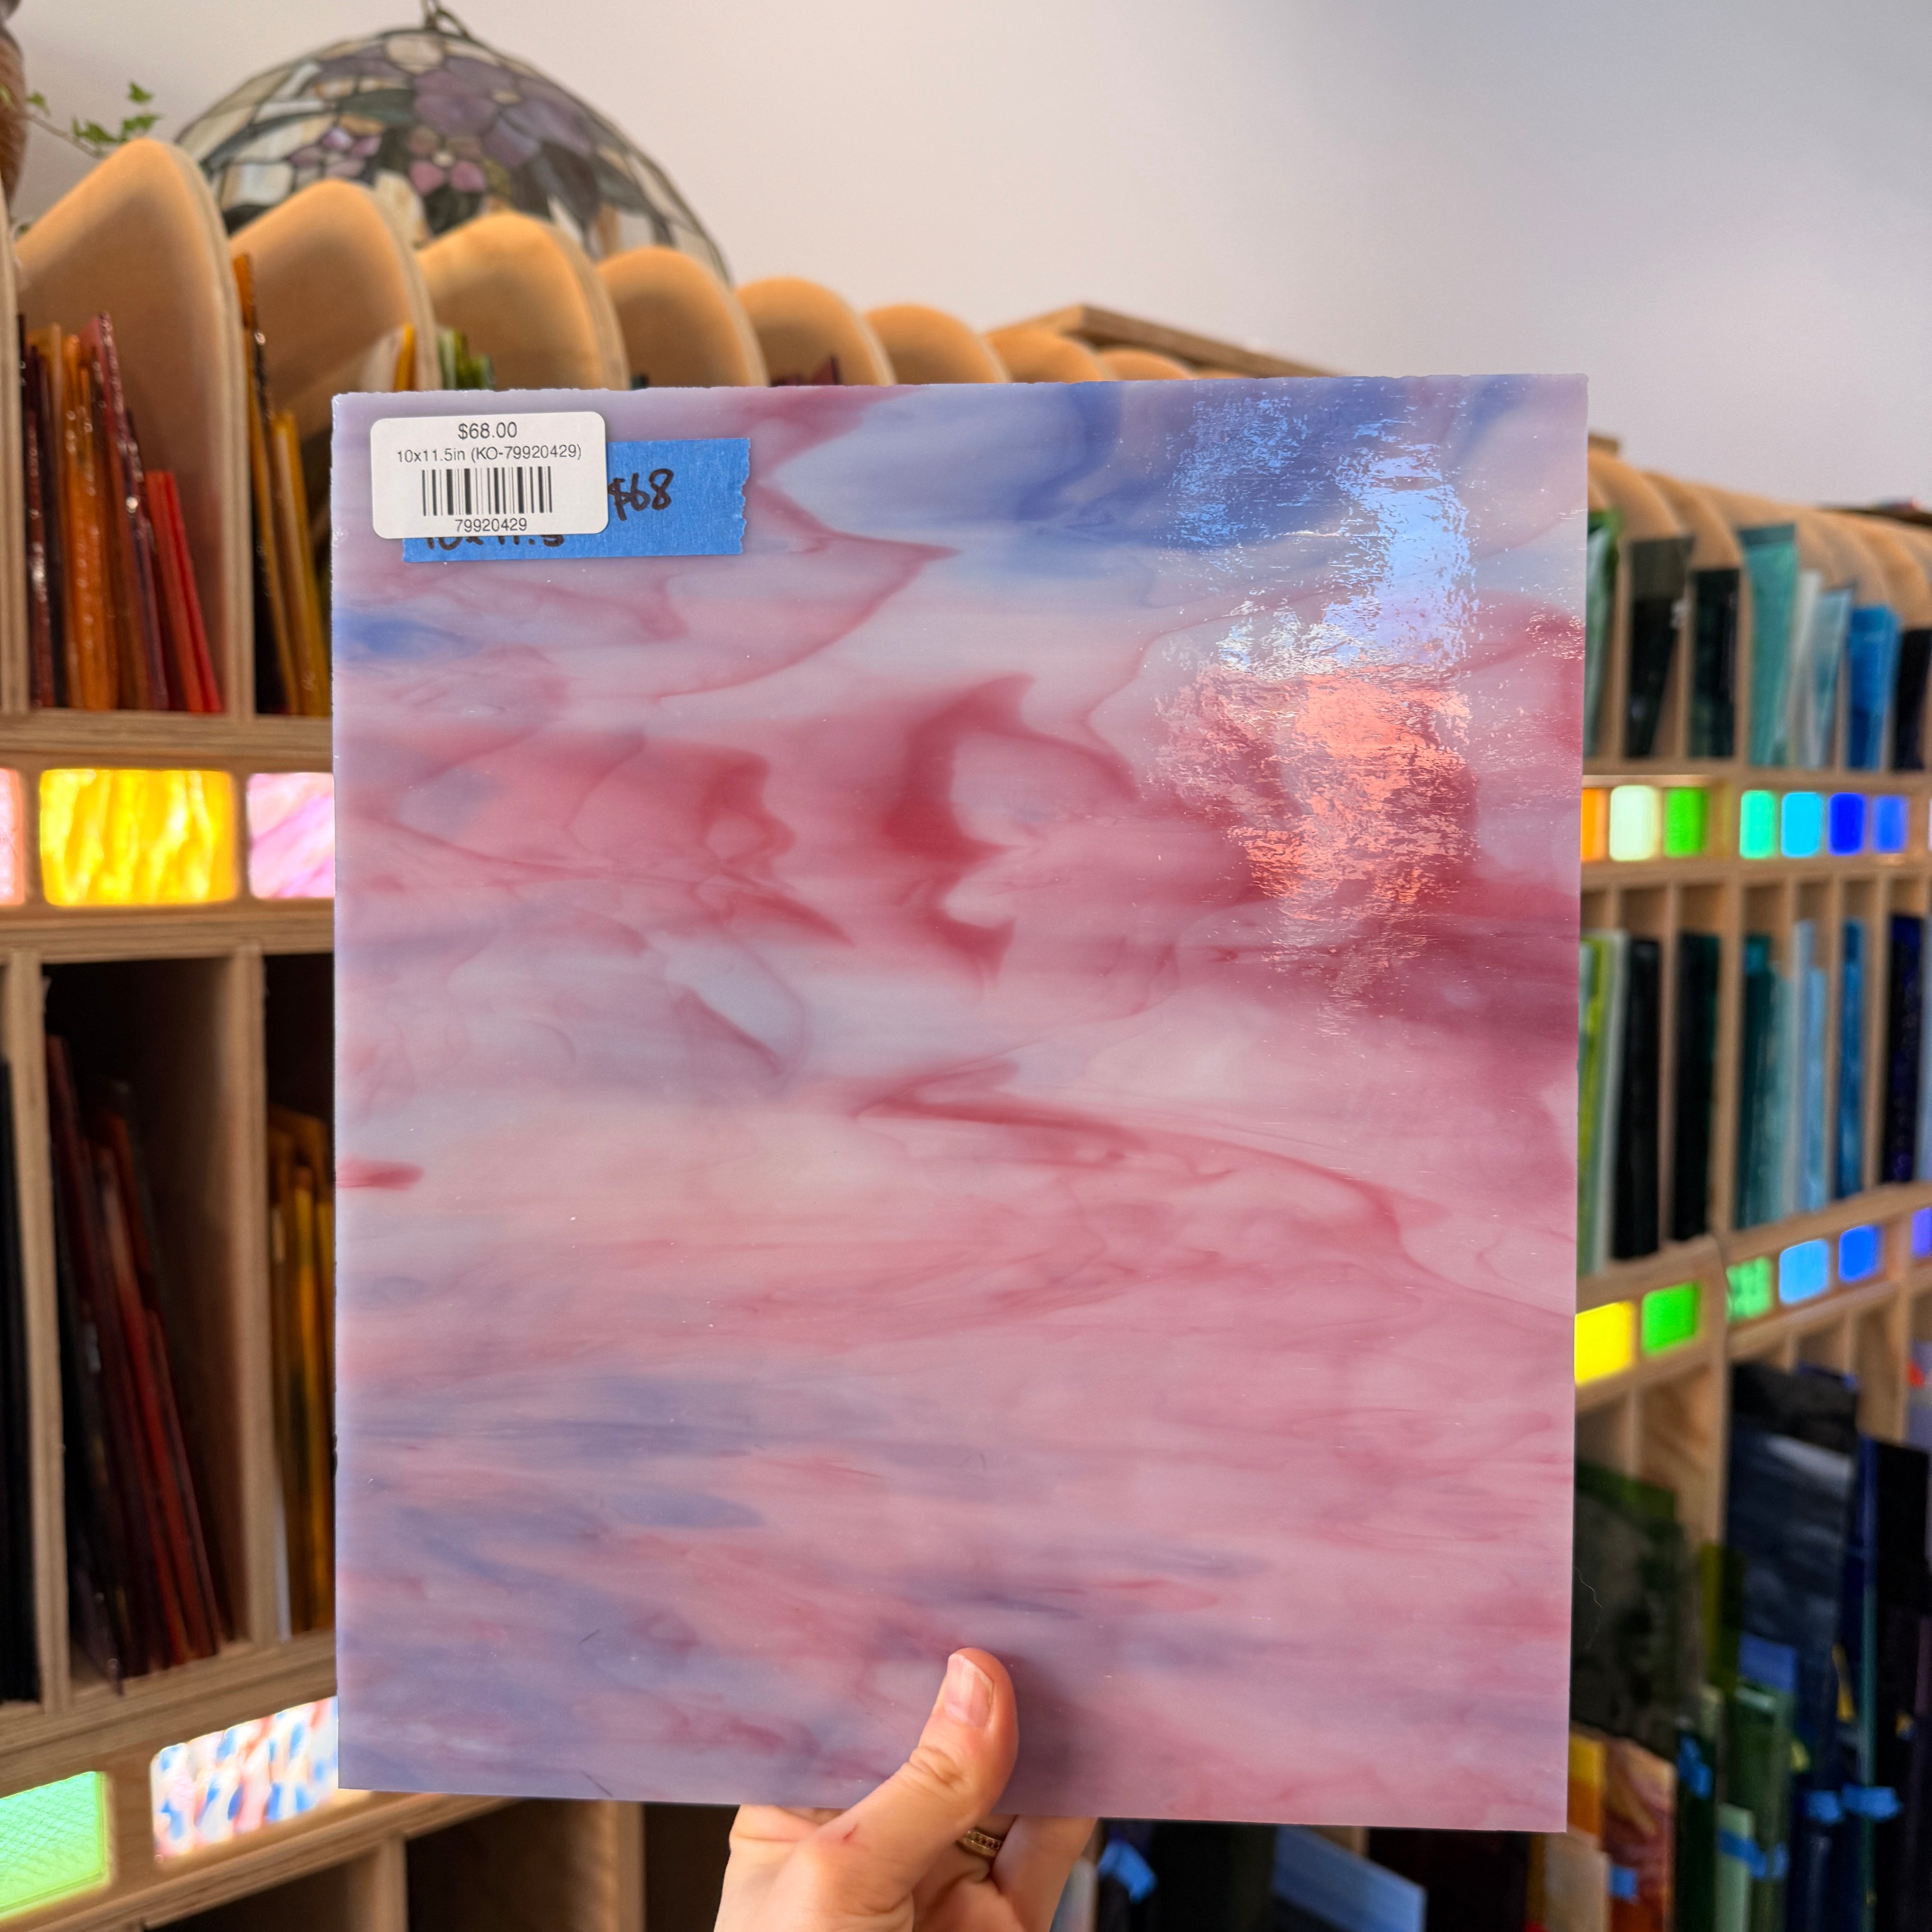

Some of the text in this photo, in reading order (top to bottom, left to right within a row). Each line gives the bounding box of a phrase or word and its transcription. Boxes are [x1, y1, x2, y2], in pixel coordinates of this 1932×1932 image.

[458, 422, 517, 440] $68.00
[397, 444, 581, 463] 10x11.5in (KO-79920429)
[455, 518, 527, 533] 79920429
